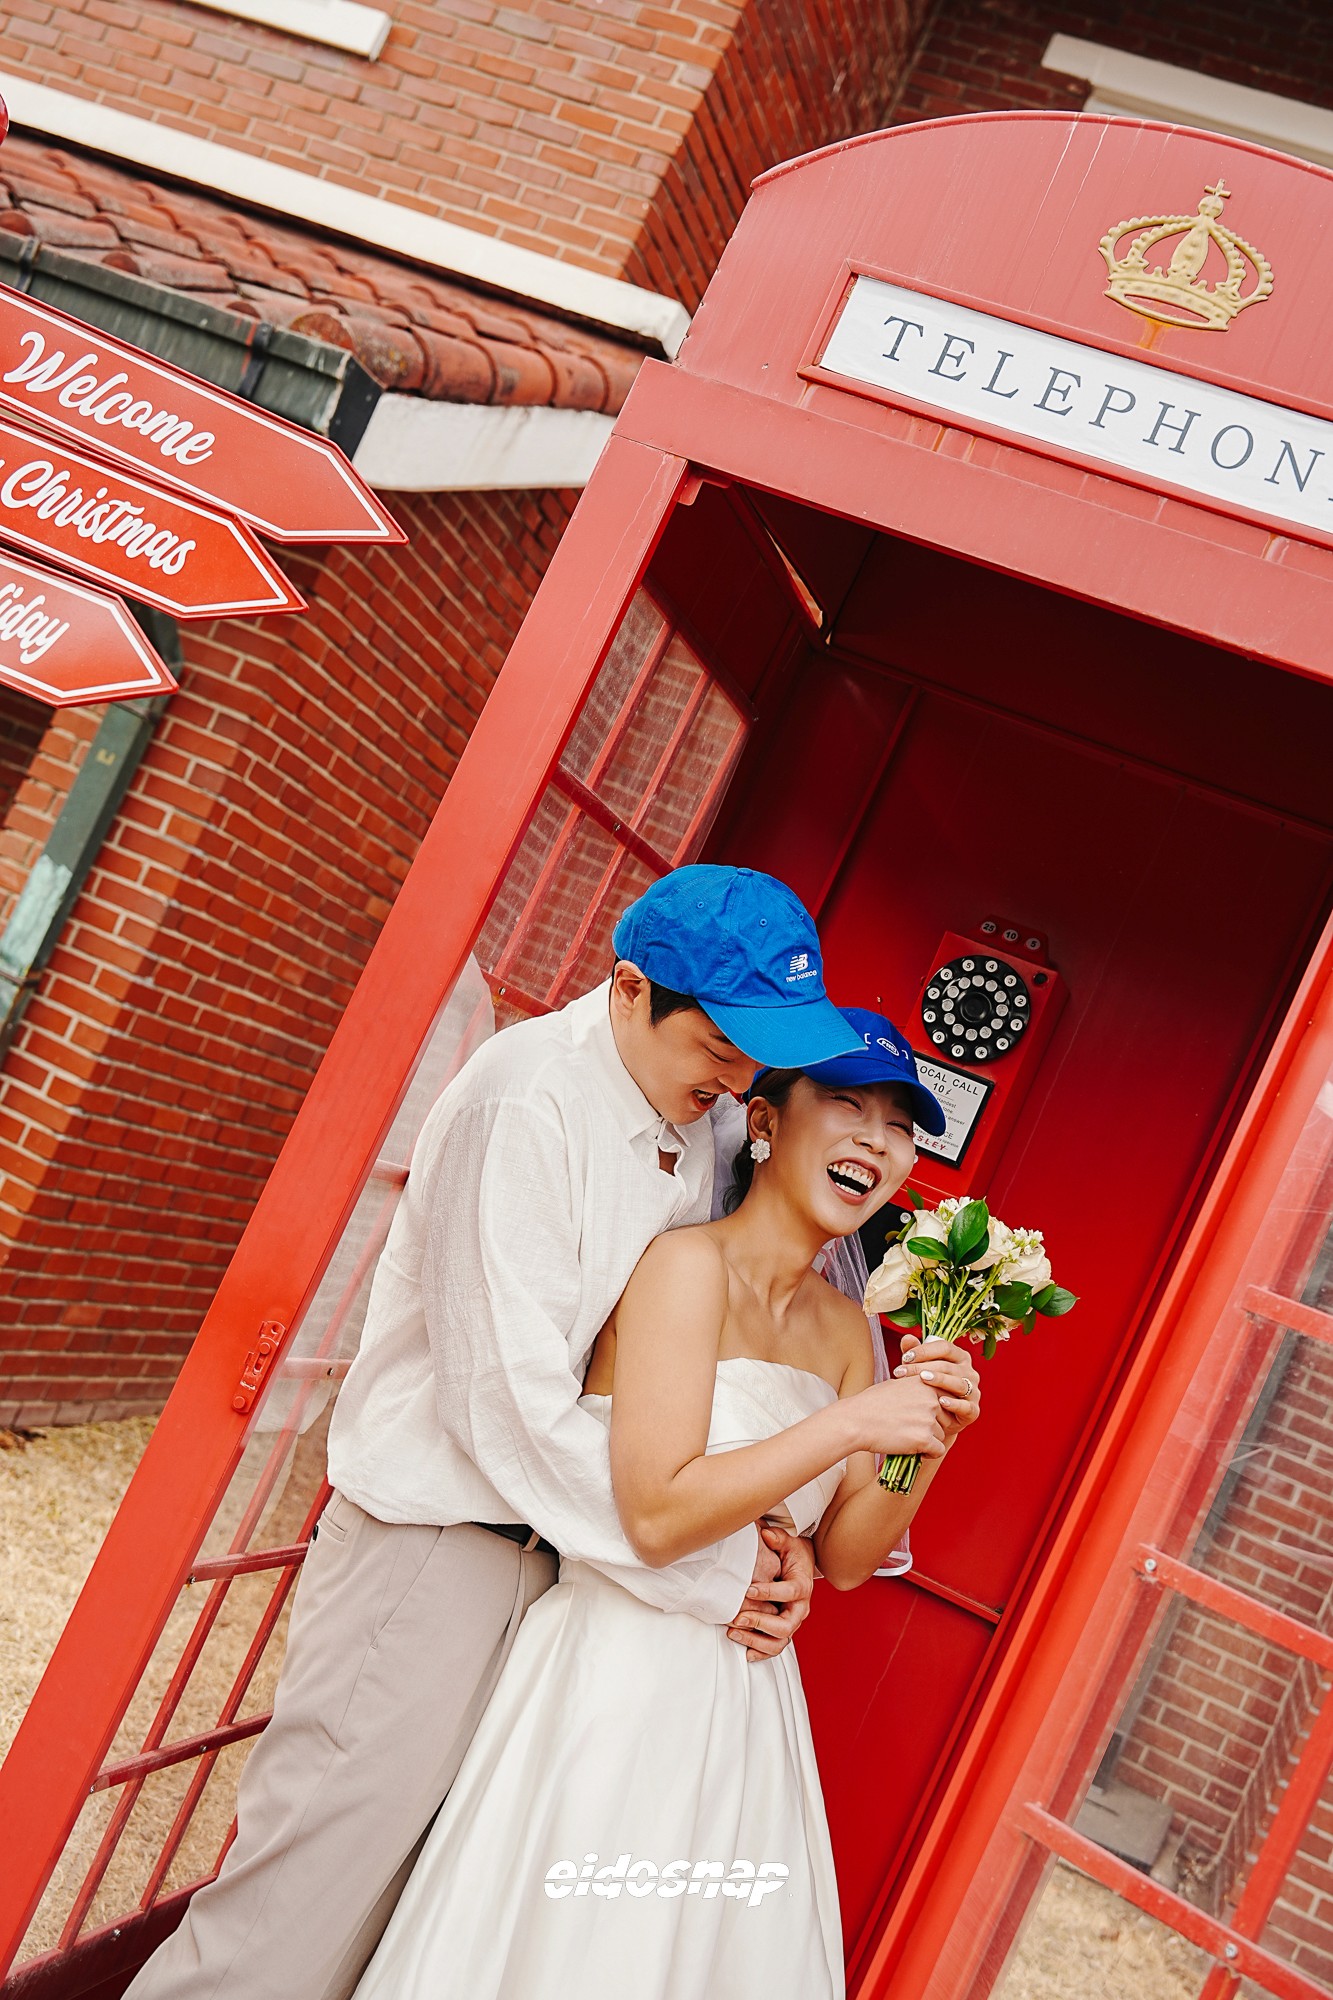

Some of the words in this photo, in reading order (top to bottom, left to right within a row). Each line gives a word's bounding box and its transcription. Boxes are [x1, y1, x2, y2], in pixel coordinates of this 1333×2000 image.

[3, 331, 216, 466] Welcome
[882, 315, 1333, 501] TELEPHON
[1, 460, 196, 576] Christmas
[983, 922, 995, 932] 25
[1005, 931, 1017, 940] 10
[797, 970, 817, 980] balance
[952, 1078, 978, 1096] CALL
